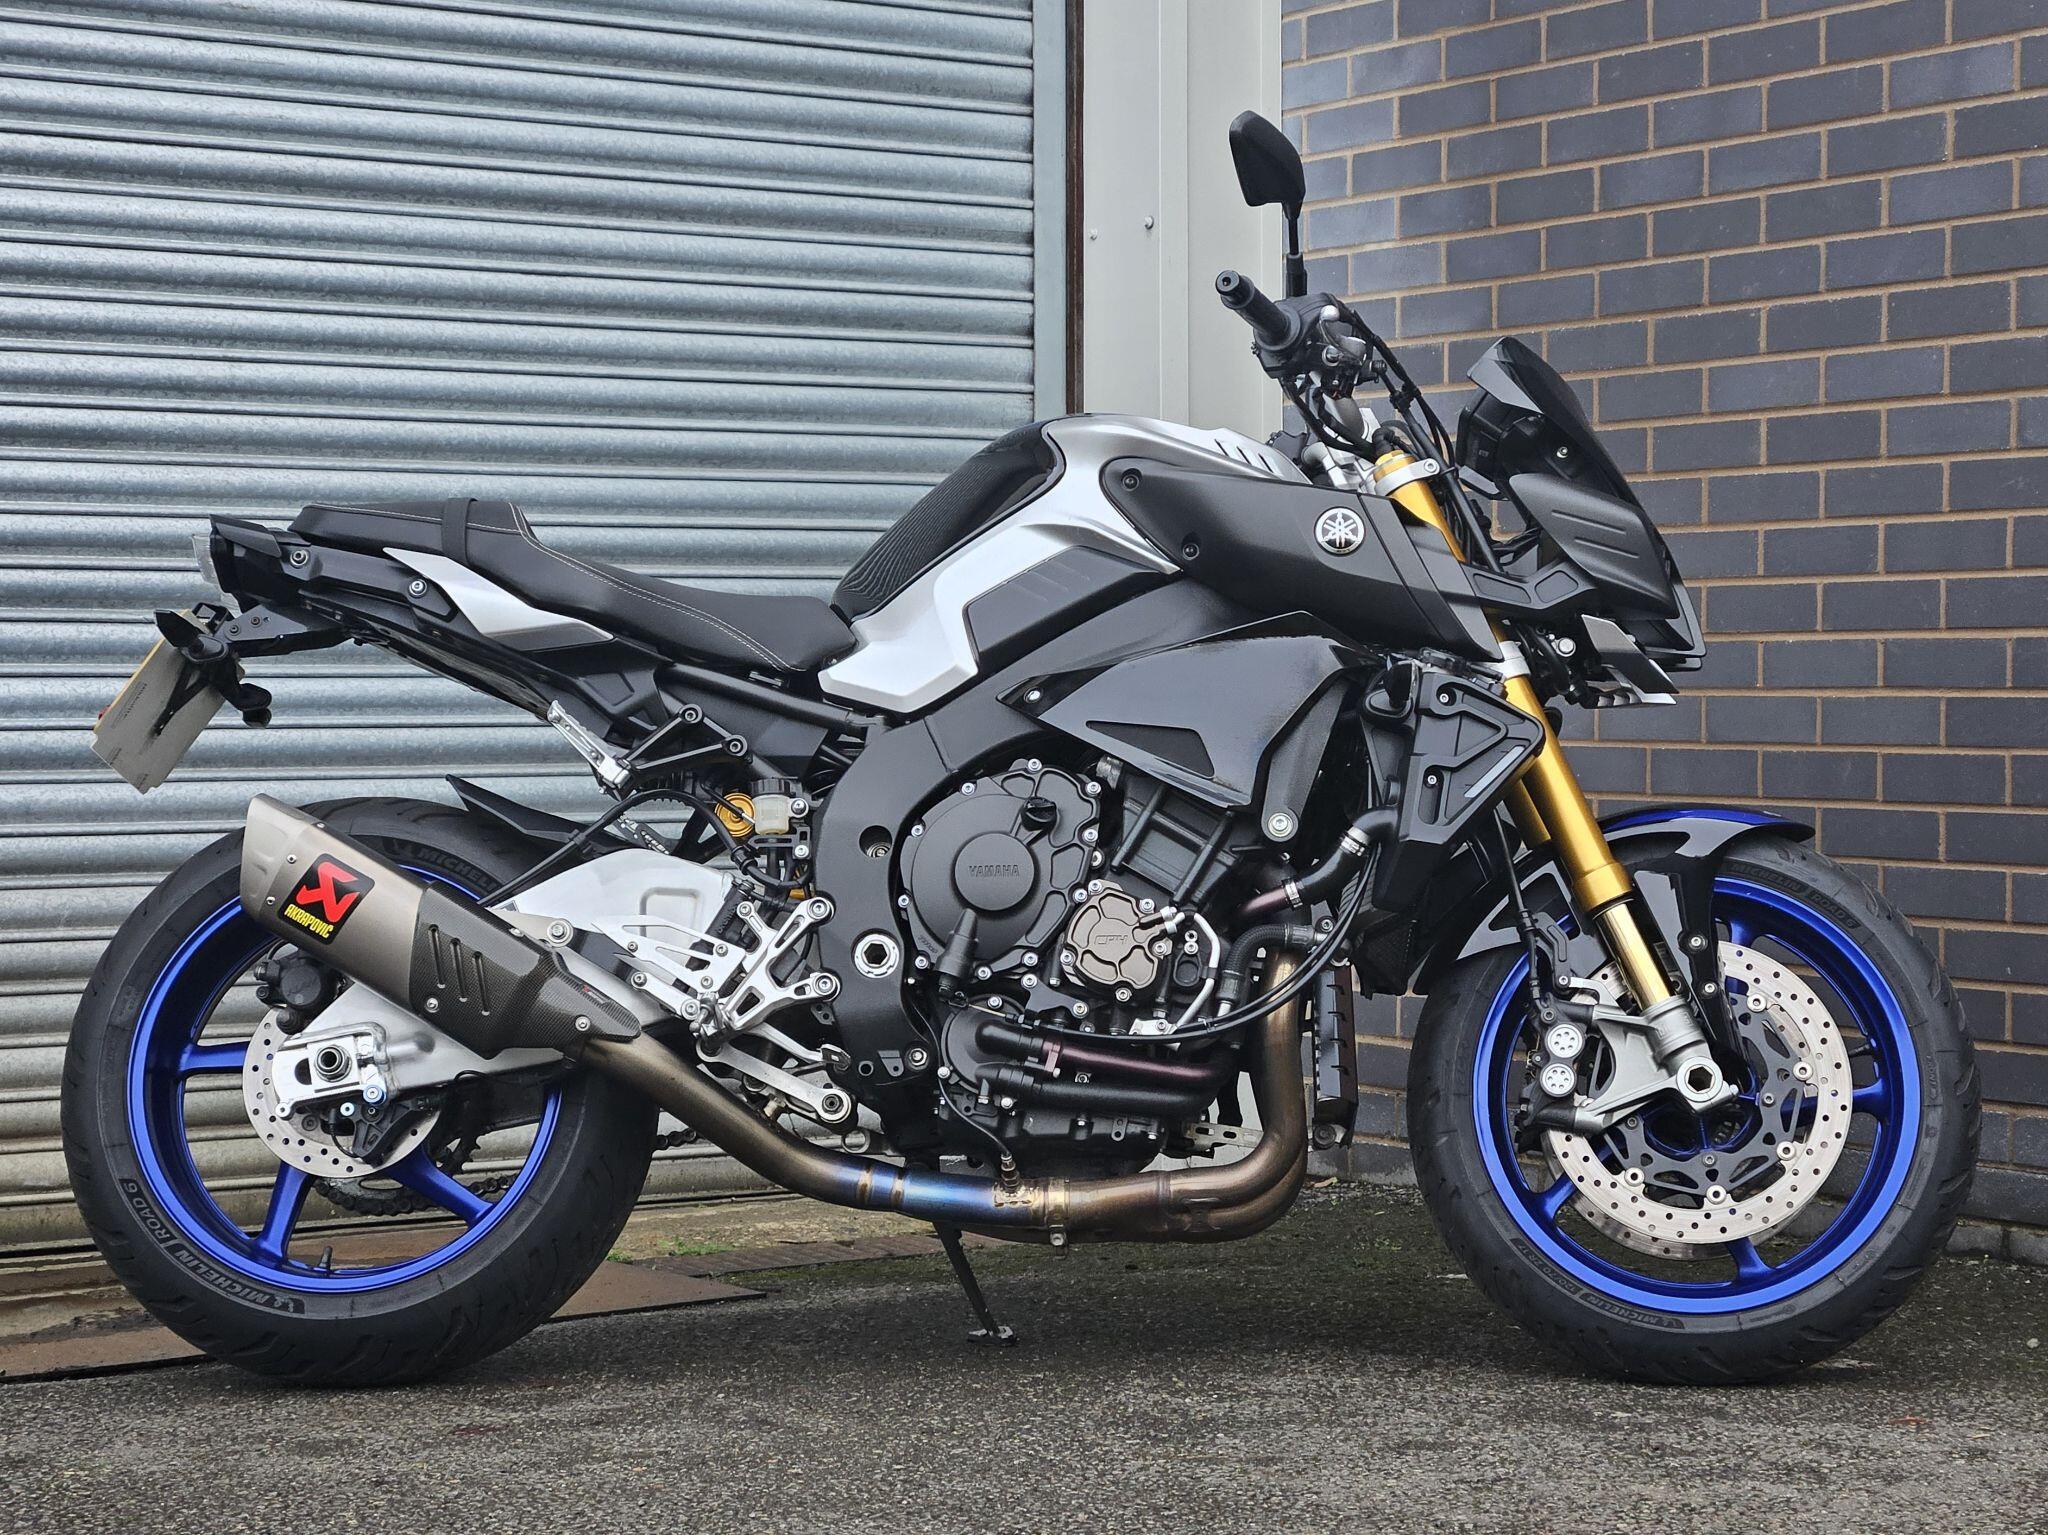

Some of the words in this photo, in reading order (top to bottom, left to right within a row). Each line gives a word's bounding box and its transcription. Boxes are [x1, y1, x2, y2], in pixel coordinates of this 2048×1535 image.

[418, 848, 498, 891] MICHELI
[968, 864, 1020, 877] YAMAHA
[1730, 863, 1799, 891] MICHELIN
[1812, 894, 1844, 919] ROAD
[126, 1182, 138, 1193] 6
[132, 1197, 170, 1241] ROAD
[175, 1249, 270, 1303] MICHELIN
[1586, 1295, 1659, 1324] MICHELIN
